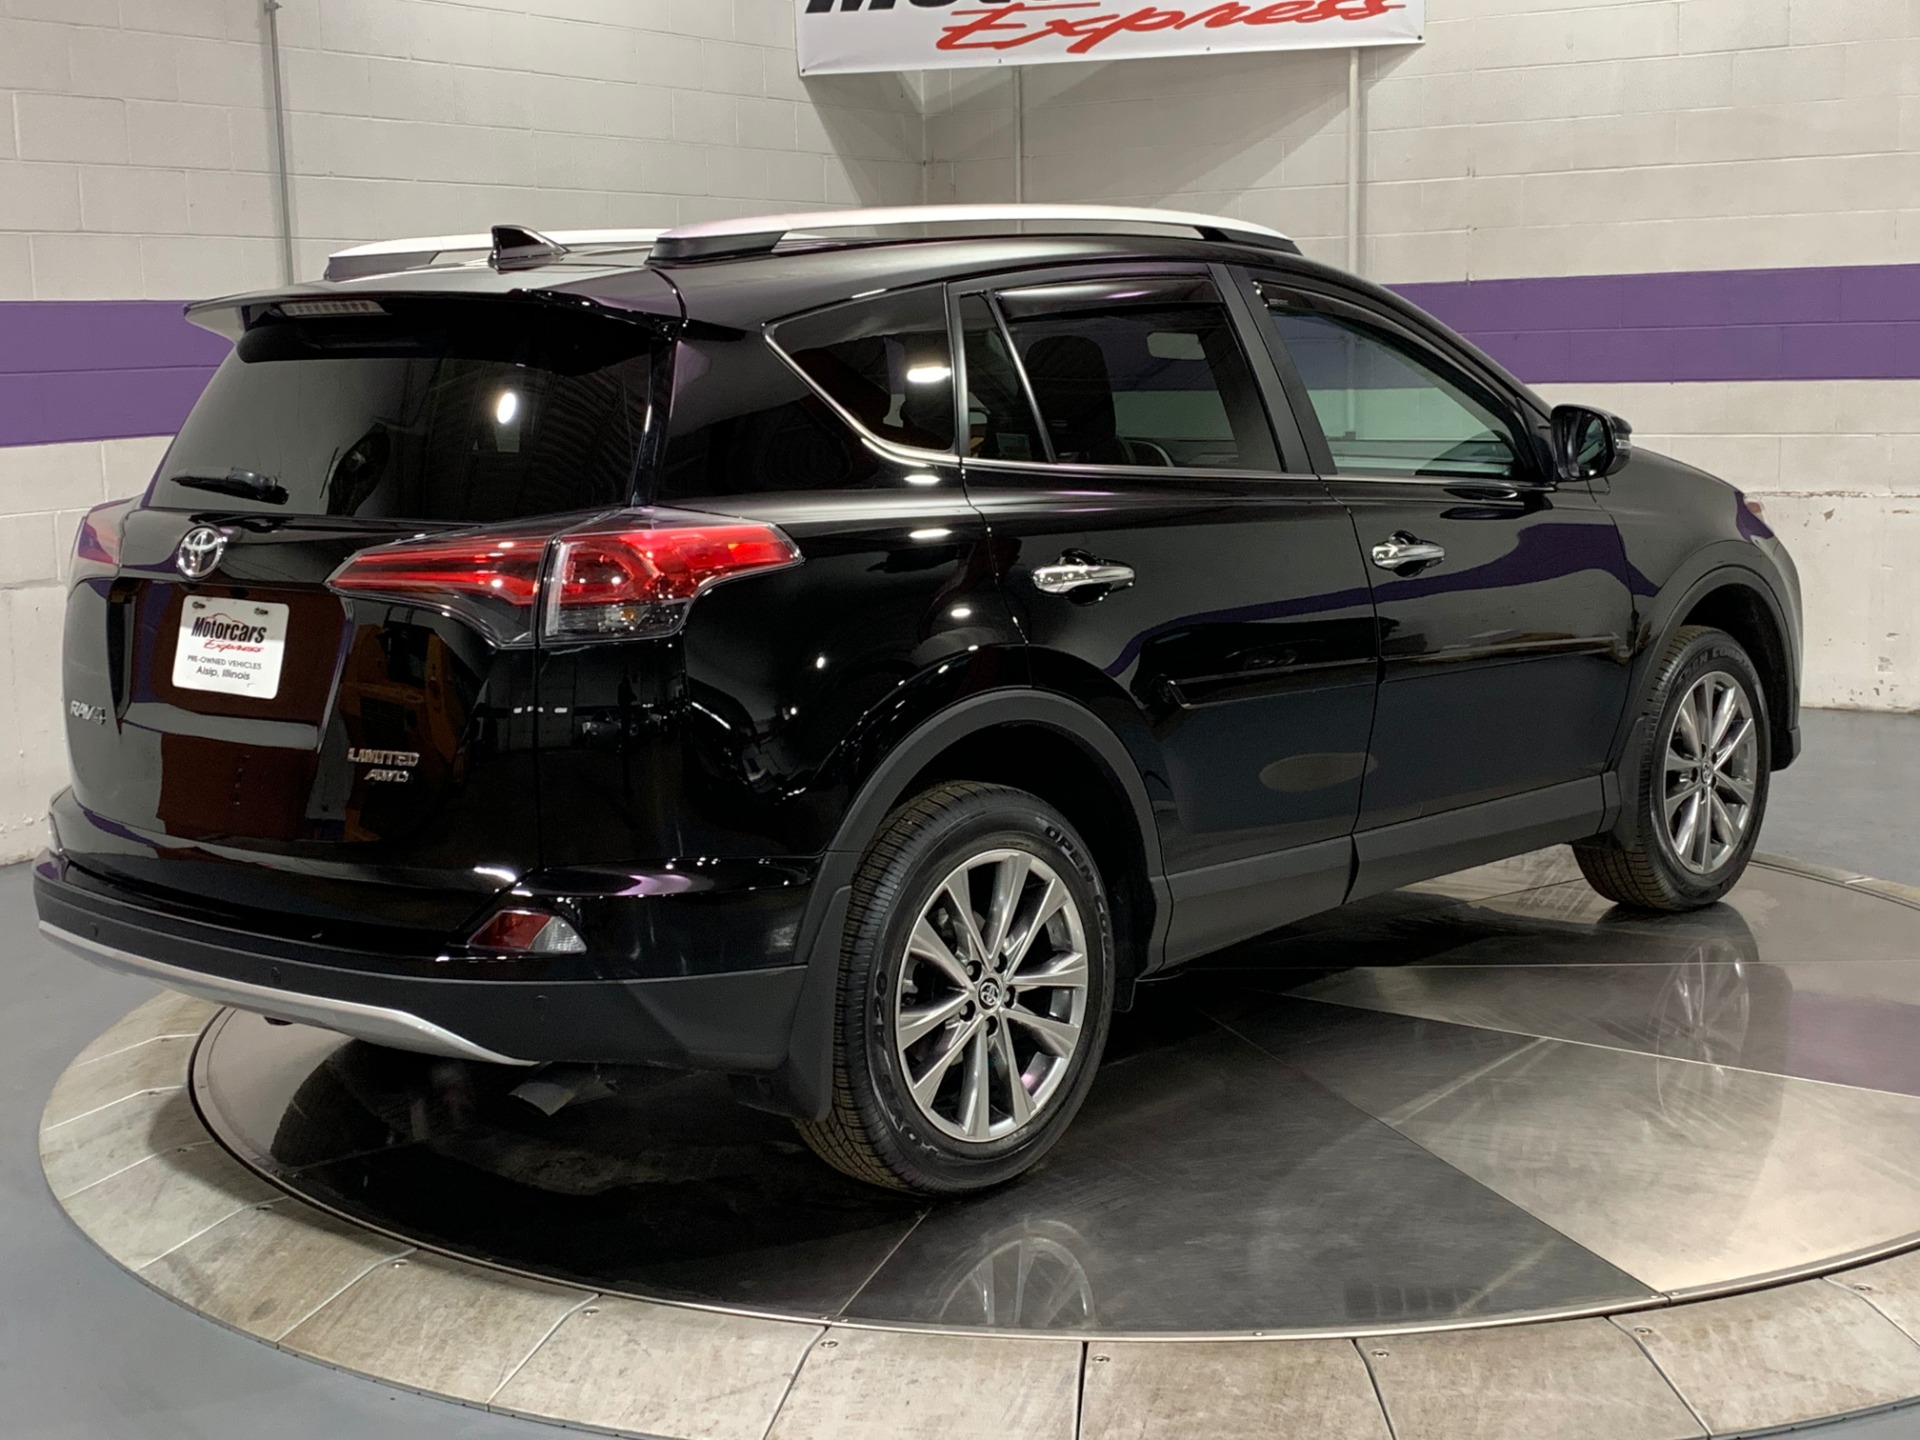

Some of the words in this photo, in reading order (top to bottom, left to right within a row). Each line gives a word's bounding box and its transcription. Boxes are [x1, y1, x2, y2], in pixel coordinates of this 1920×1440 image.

[936, 0, 1406, 53] Express
[191, 616, 267, 643] Motorcars
[203, 639, 264, 652] Express
[187, 654, 226, 666] PRE-OWNED
[227, 659, 262, 670] VEHICLES
[221, 668, 250, 680] Illinois
[347, 747, 420, 767] LIMITED
[363, 768, 410, 783] AWD
